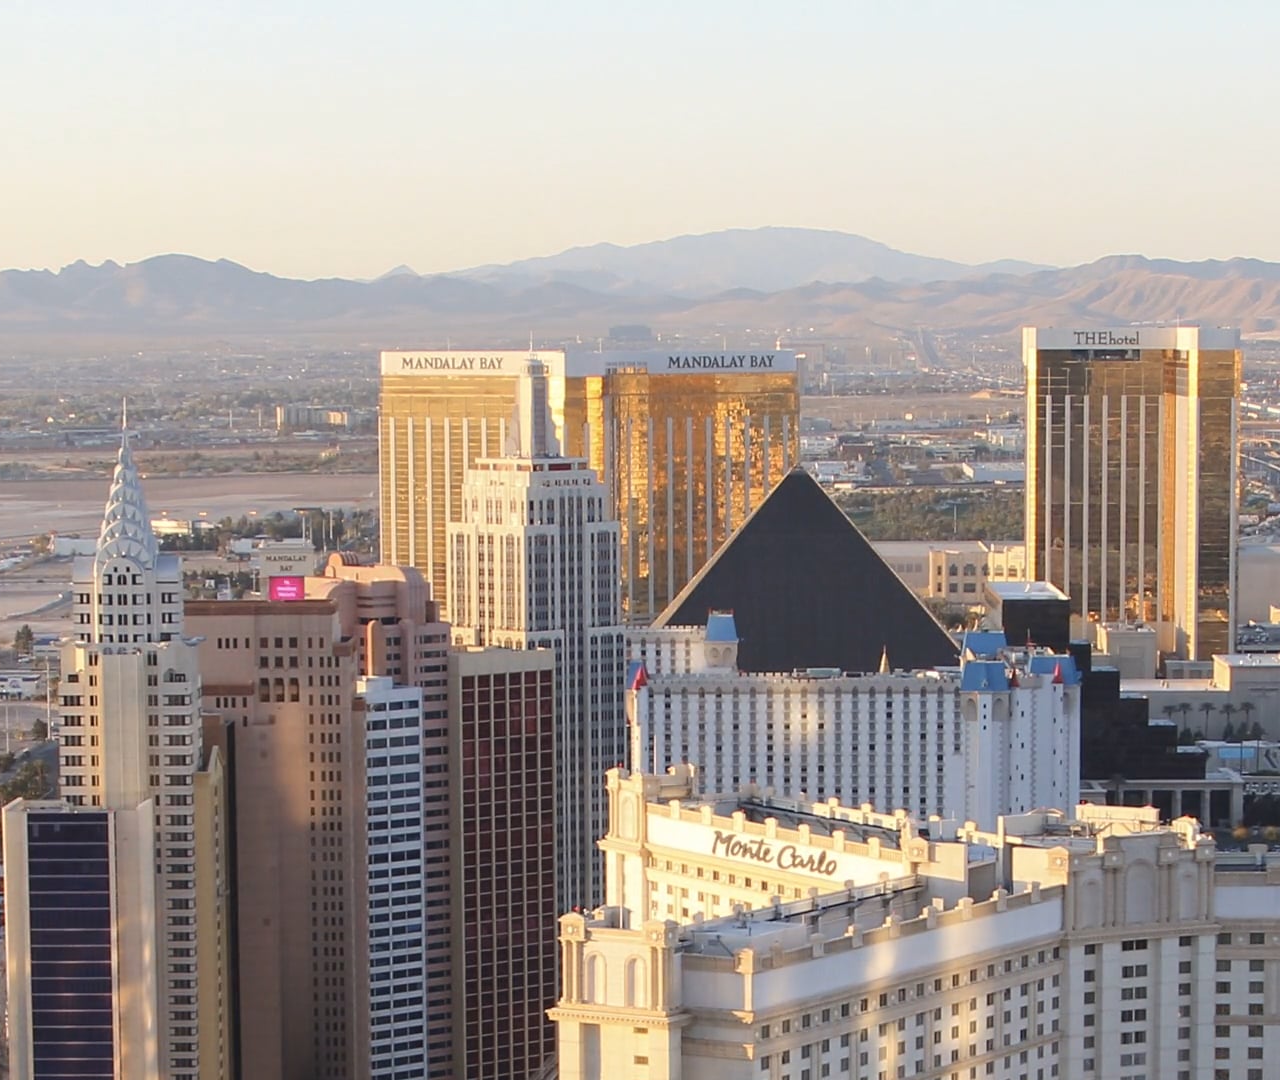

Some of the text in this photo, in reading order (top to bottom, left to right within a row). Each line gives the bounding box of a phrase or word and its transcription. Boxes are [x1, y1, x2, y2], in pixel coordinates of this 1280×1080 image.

[401, 357, 504, 370] MANDALAY BAY
[668, 355, 775, 369] MANDALAY BAY
[712, 830, 838, 876] Monte Carlo
